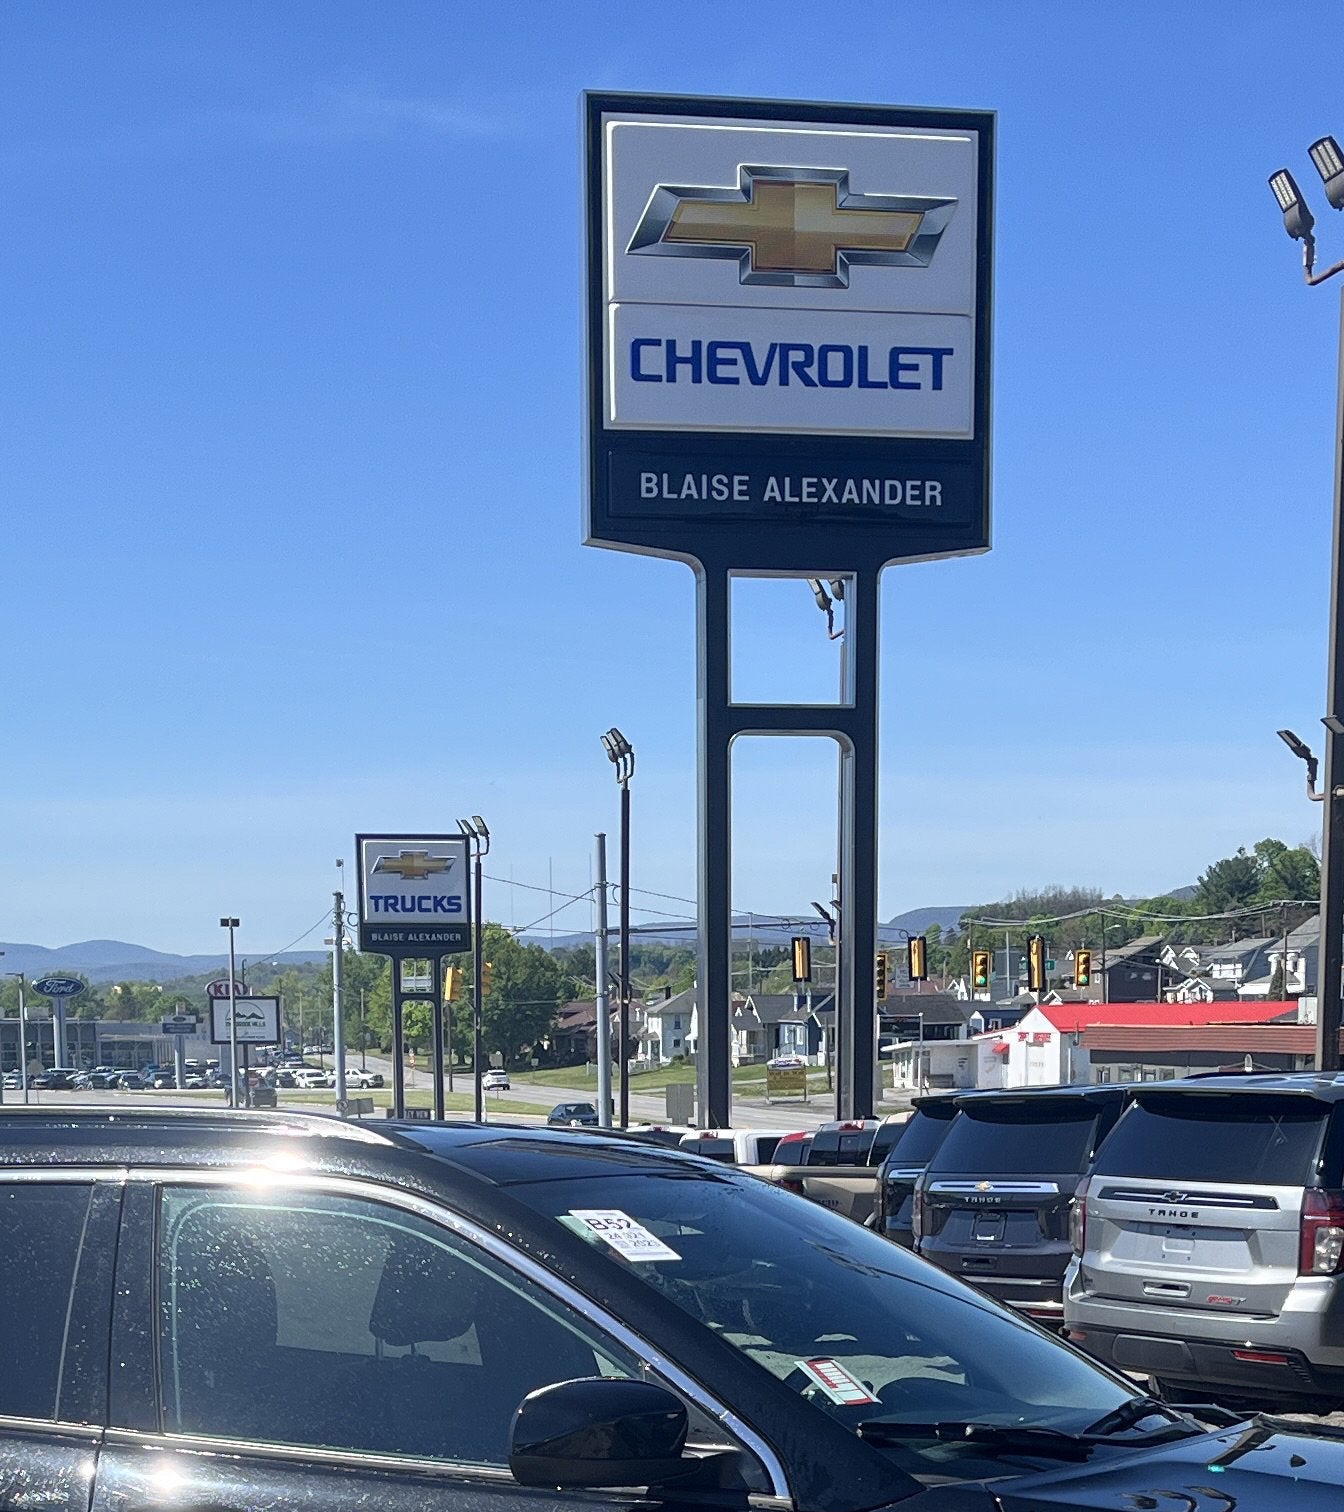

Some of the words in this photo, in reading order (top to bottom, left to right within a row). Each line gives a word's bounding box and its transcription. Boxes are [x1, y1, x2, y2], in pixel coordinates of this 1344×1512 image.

[630, 337, 955, 391] CHEVROLET
[640, 472, 750, 501] BLAISE
[762, 475, 943, 507] ALEXANDER
[369, 895, 462, 913] TRUCKS
[371, 932, 404, 942] BLAISE
[407, 932, 462, 942] ALEXANDER
[43, 980, 74, 993] Ford
[1148, 1208, 1200, 1219] TAHOE
